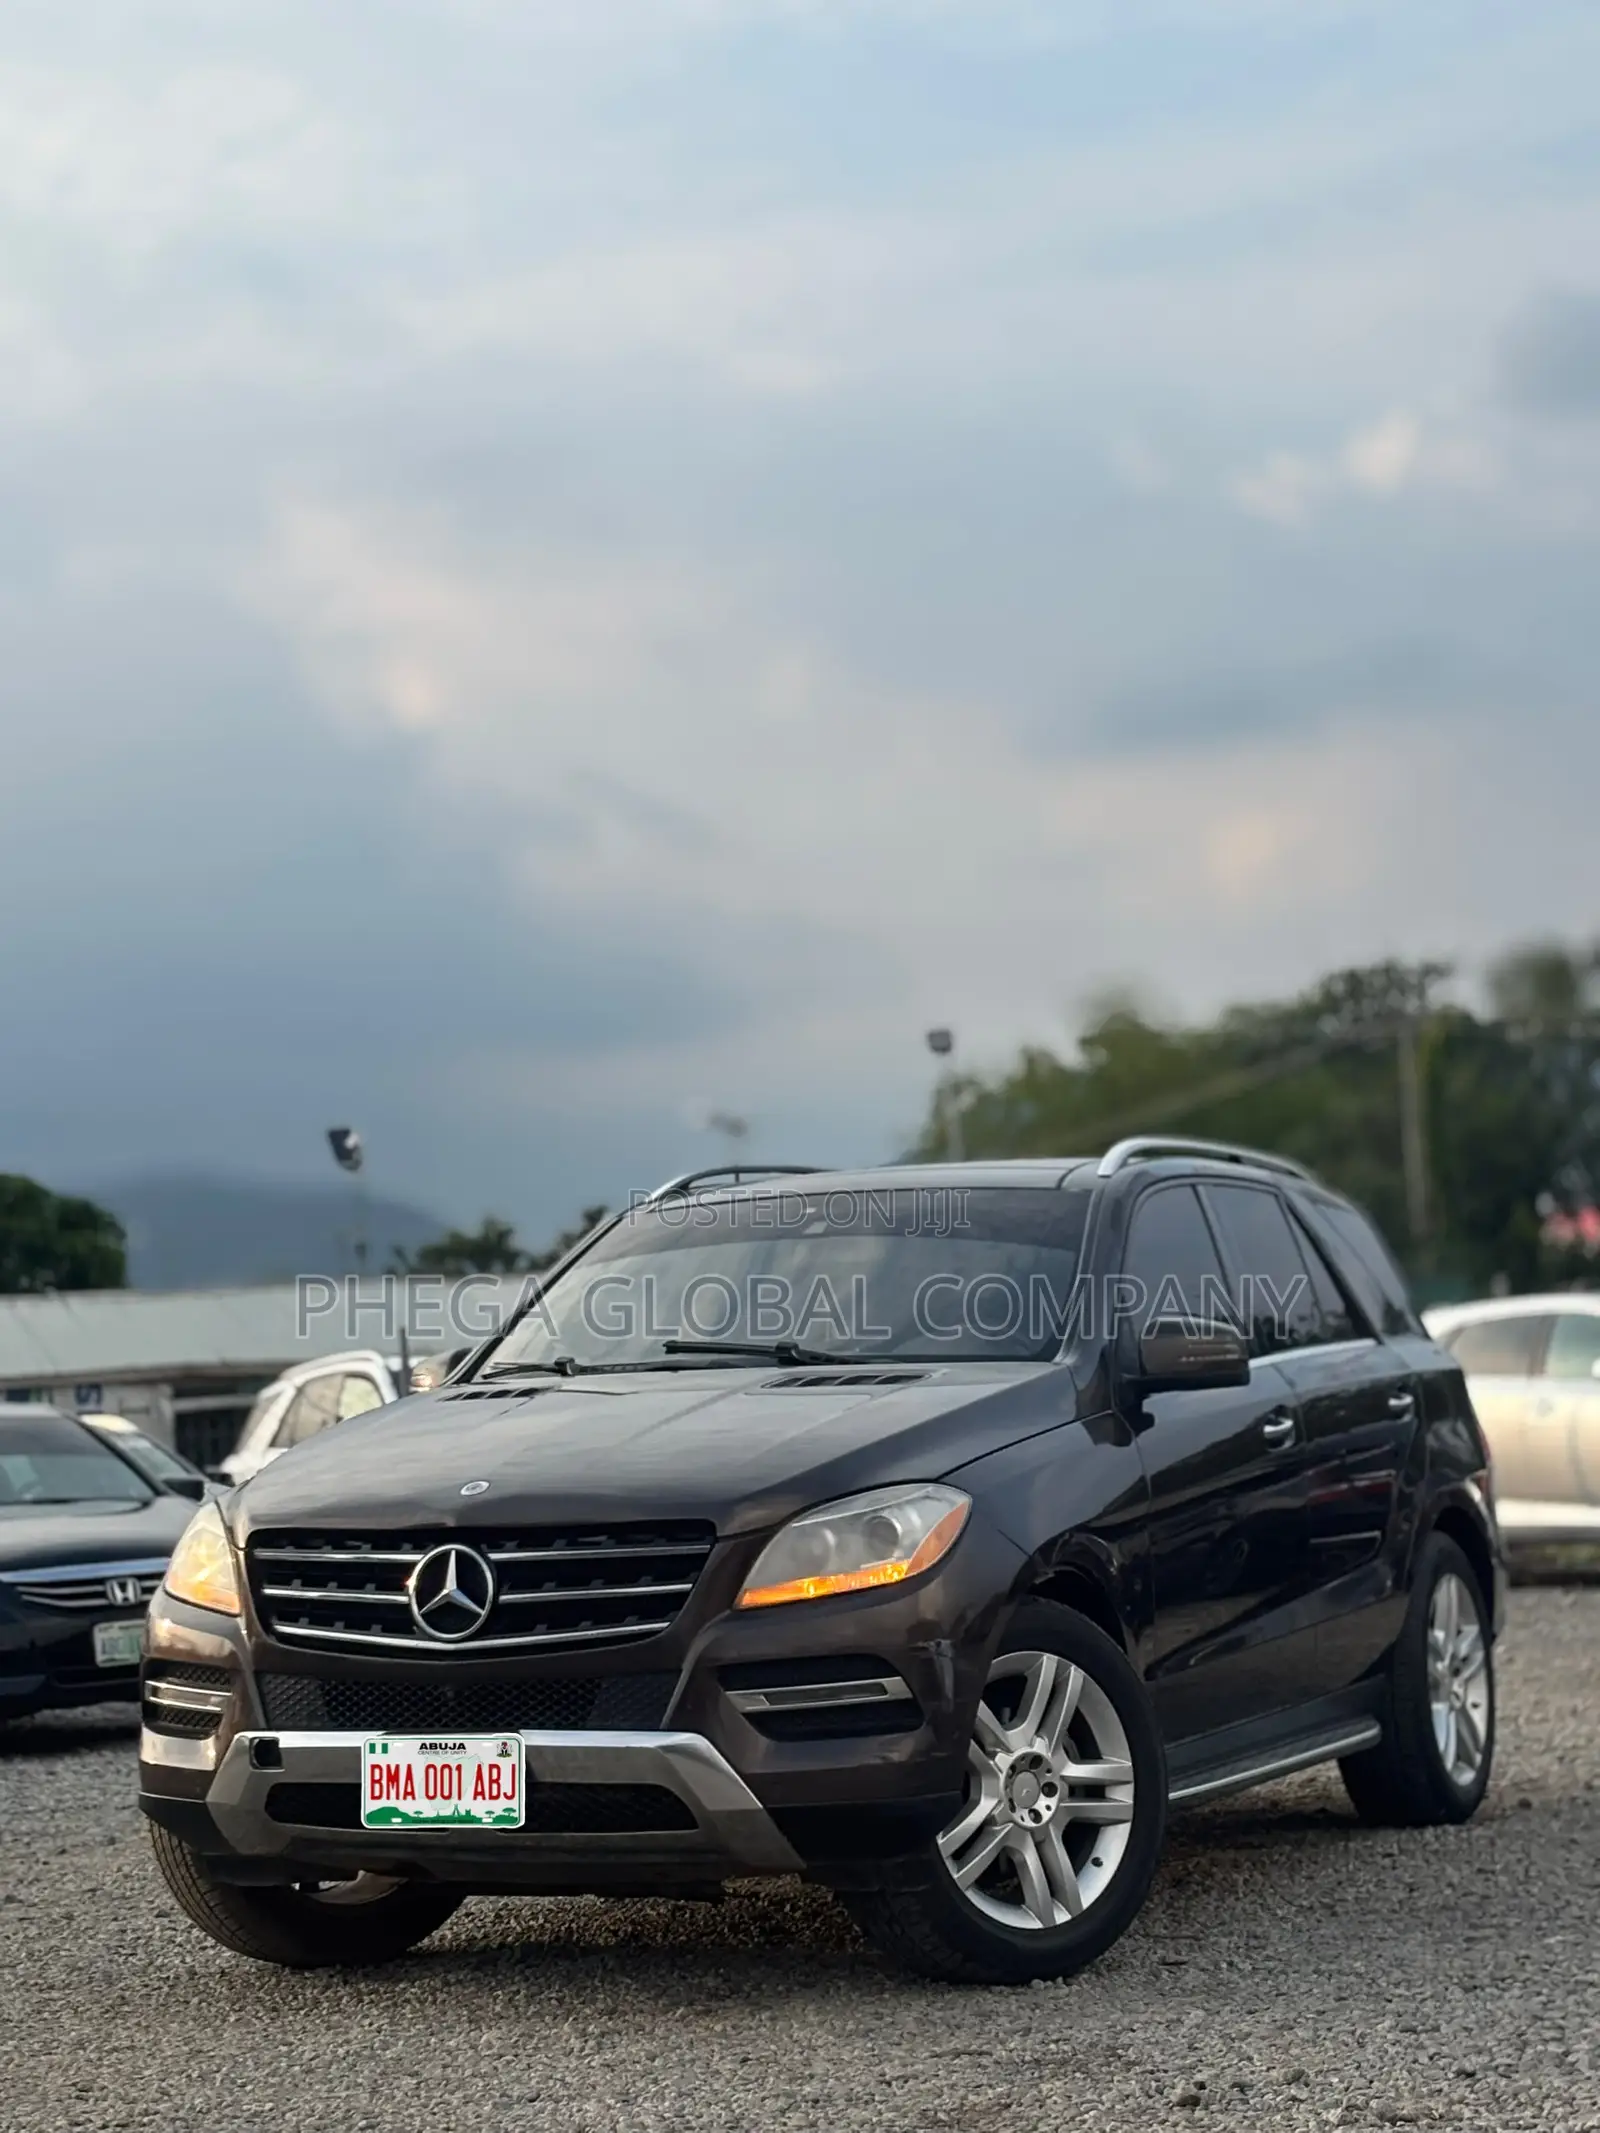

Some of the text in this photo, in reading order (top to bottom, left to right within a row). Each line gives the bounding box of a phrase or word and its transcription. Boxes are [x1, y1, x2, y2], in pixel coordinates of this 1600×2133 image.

[419, 1742, 466, 1750] ABUJA
[370, 1764, 516, 1801] BMA 001 ABJ
